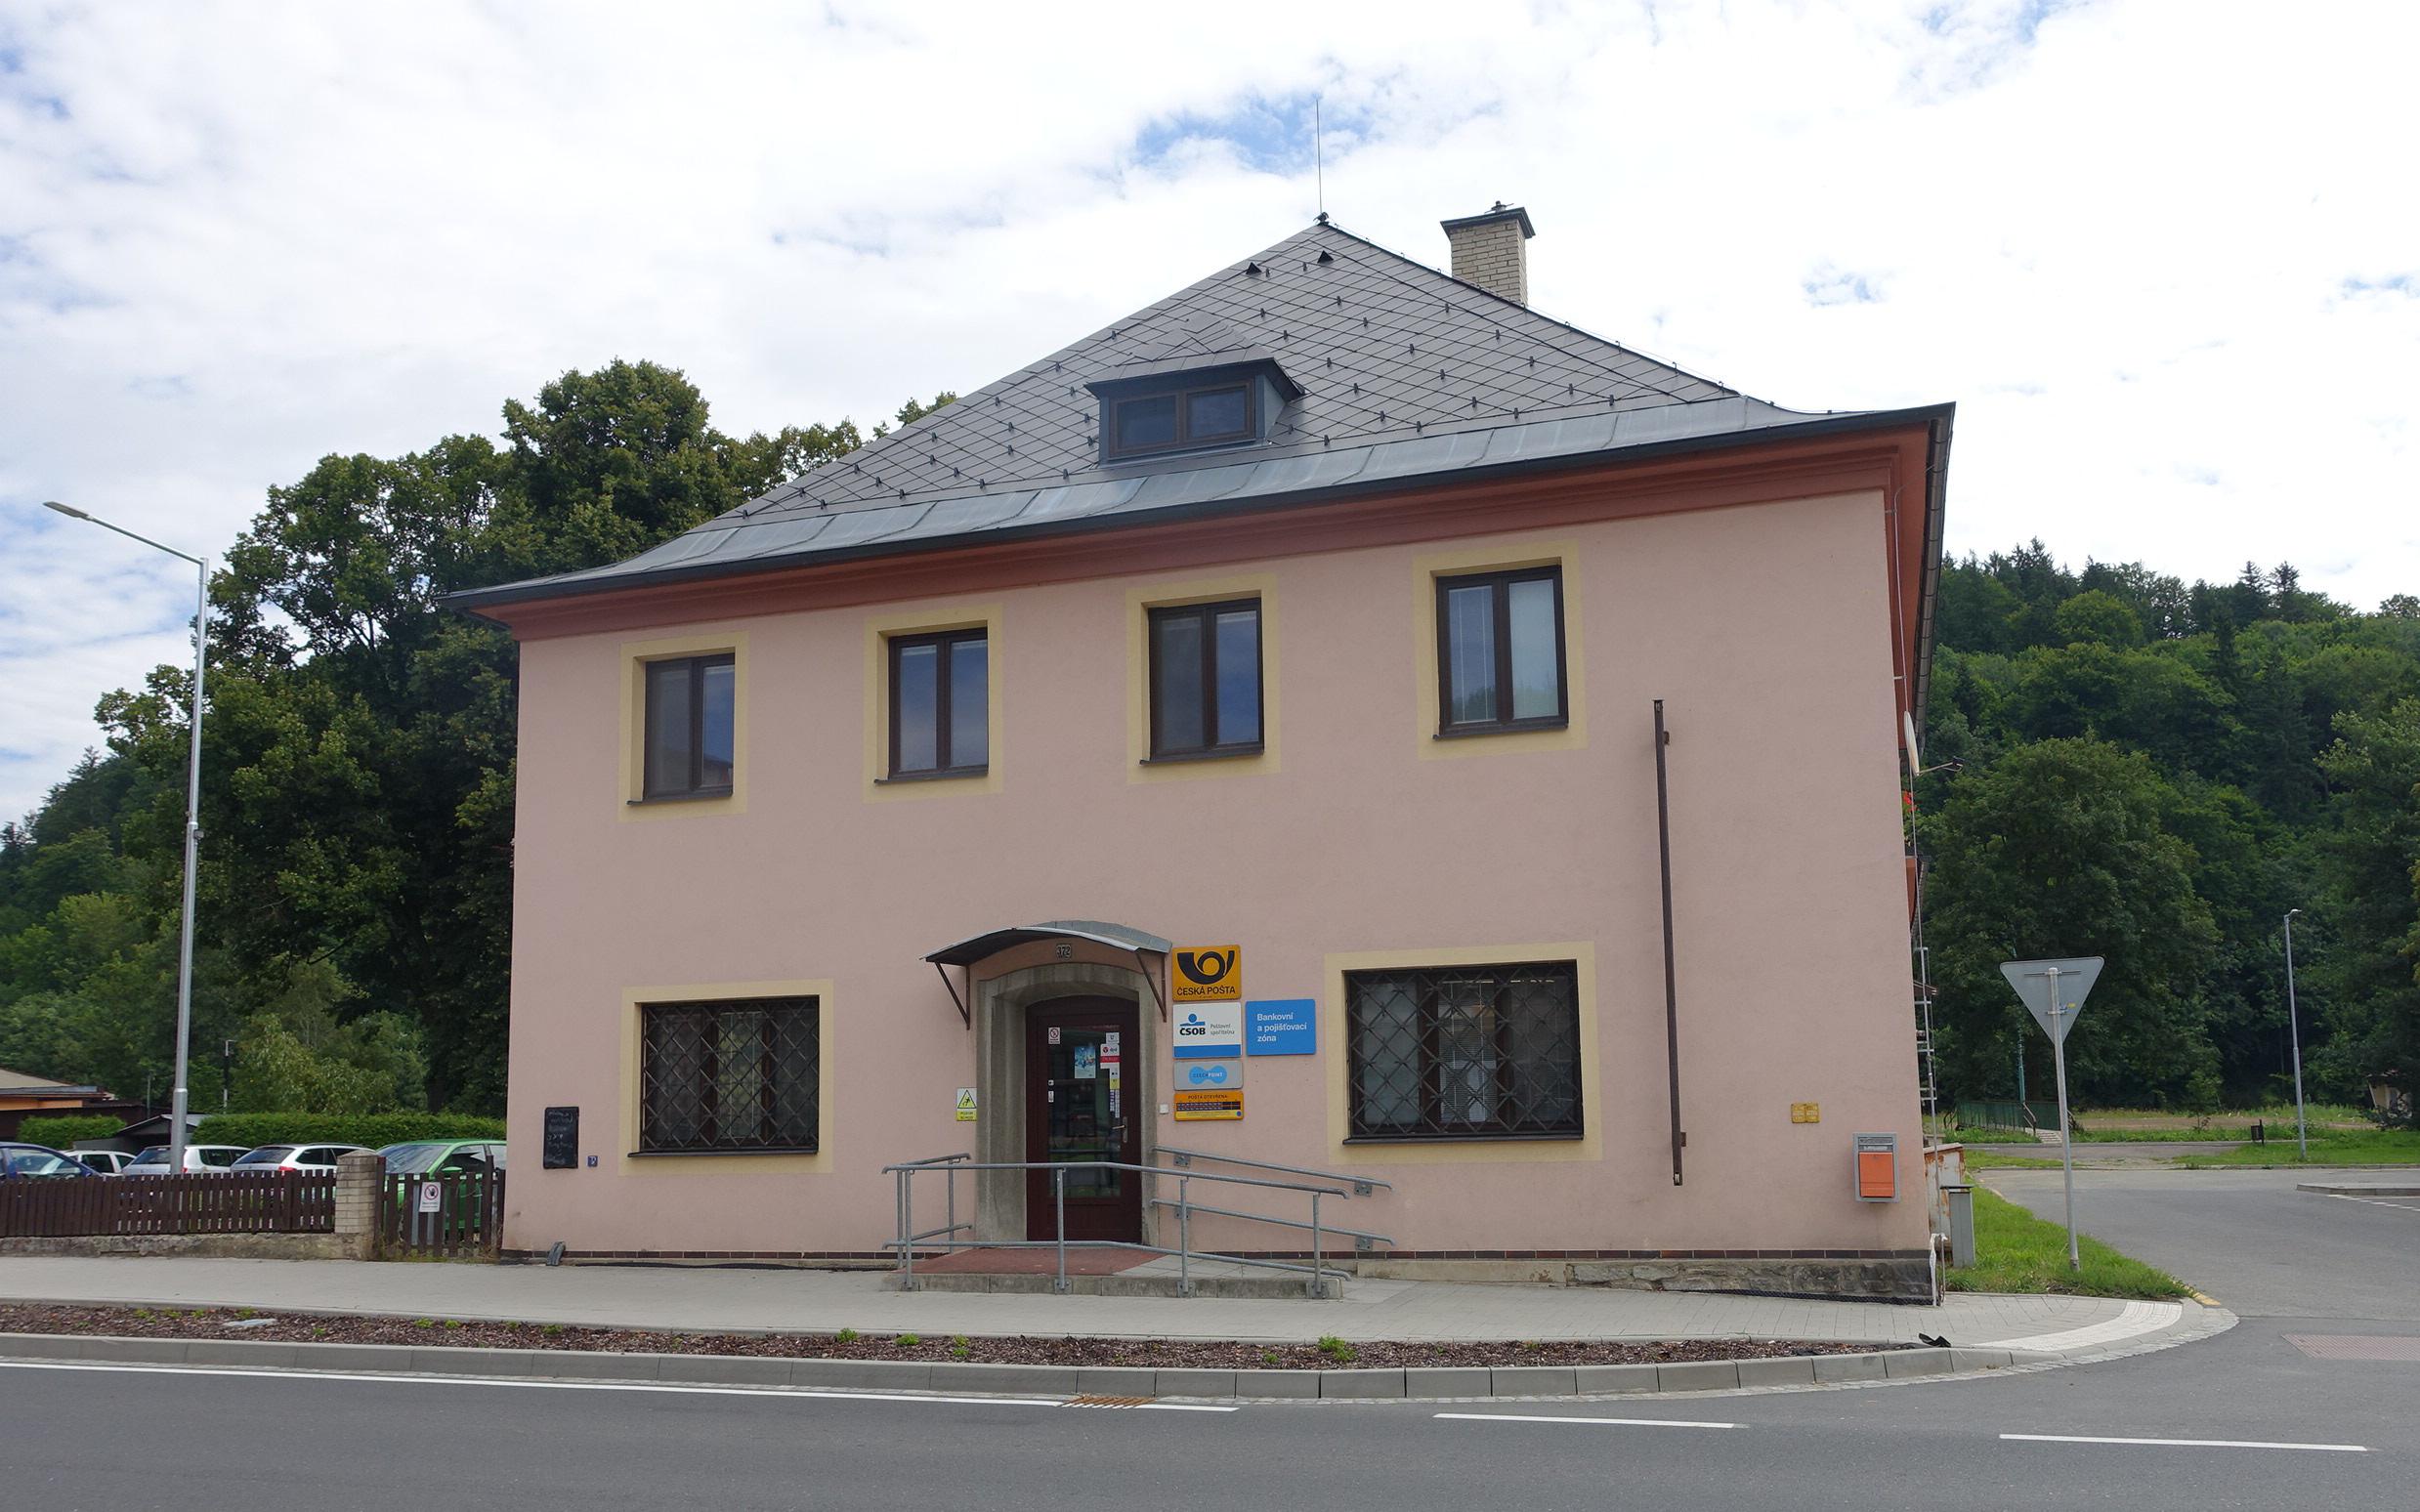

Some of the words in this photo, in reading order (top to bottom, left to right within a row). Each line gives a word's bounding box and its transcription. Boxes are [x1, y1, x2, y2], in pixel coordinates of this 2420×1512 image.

[1056, 945, 1071, 958] 372
[1176, 986, 1206, 996] ČESKÁ
[1207, 985, 1236, 994] POŠTA
[1256, 1012, 1294, 1022] Bankovní
[1179, 1027, 1206, 1036] ČSOB
[1264, 1022, 1307, 1032] pojišťovací
[1257, 1034, 1277, 1043] zóna
